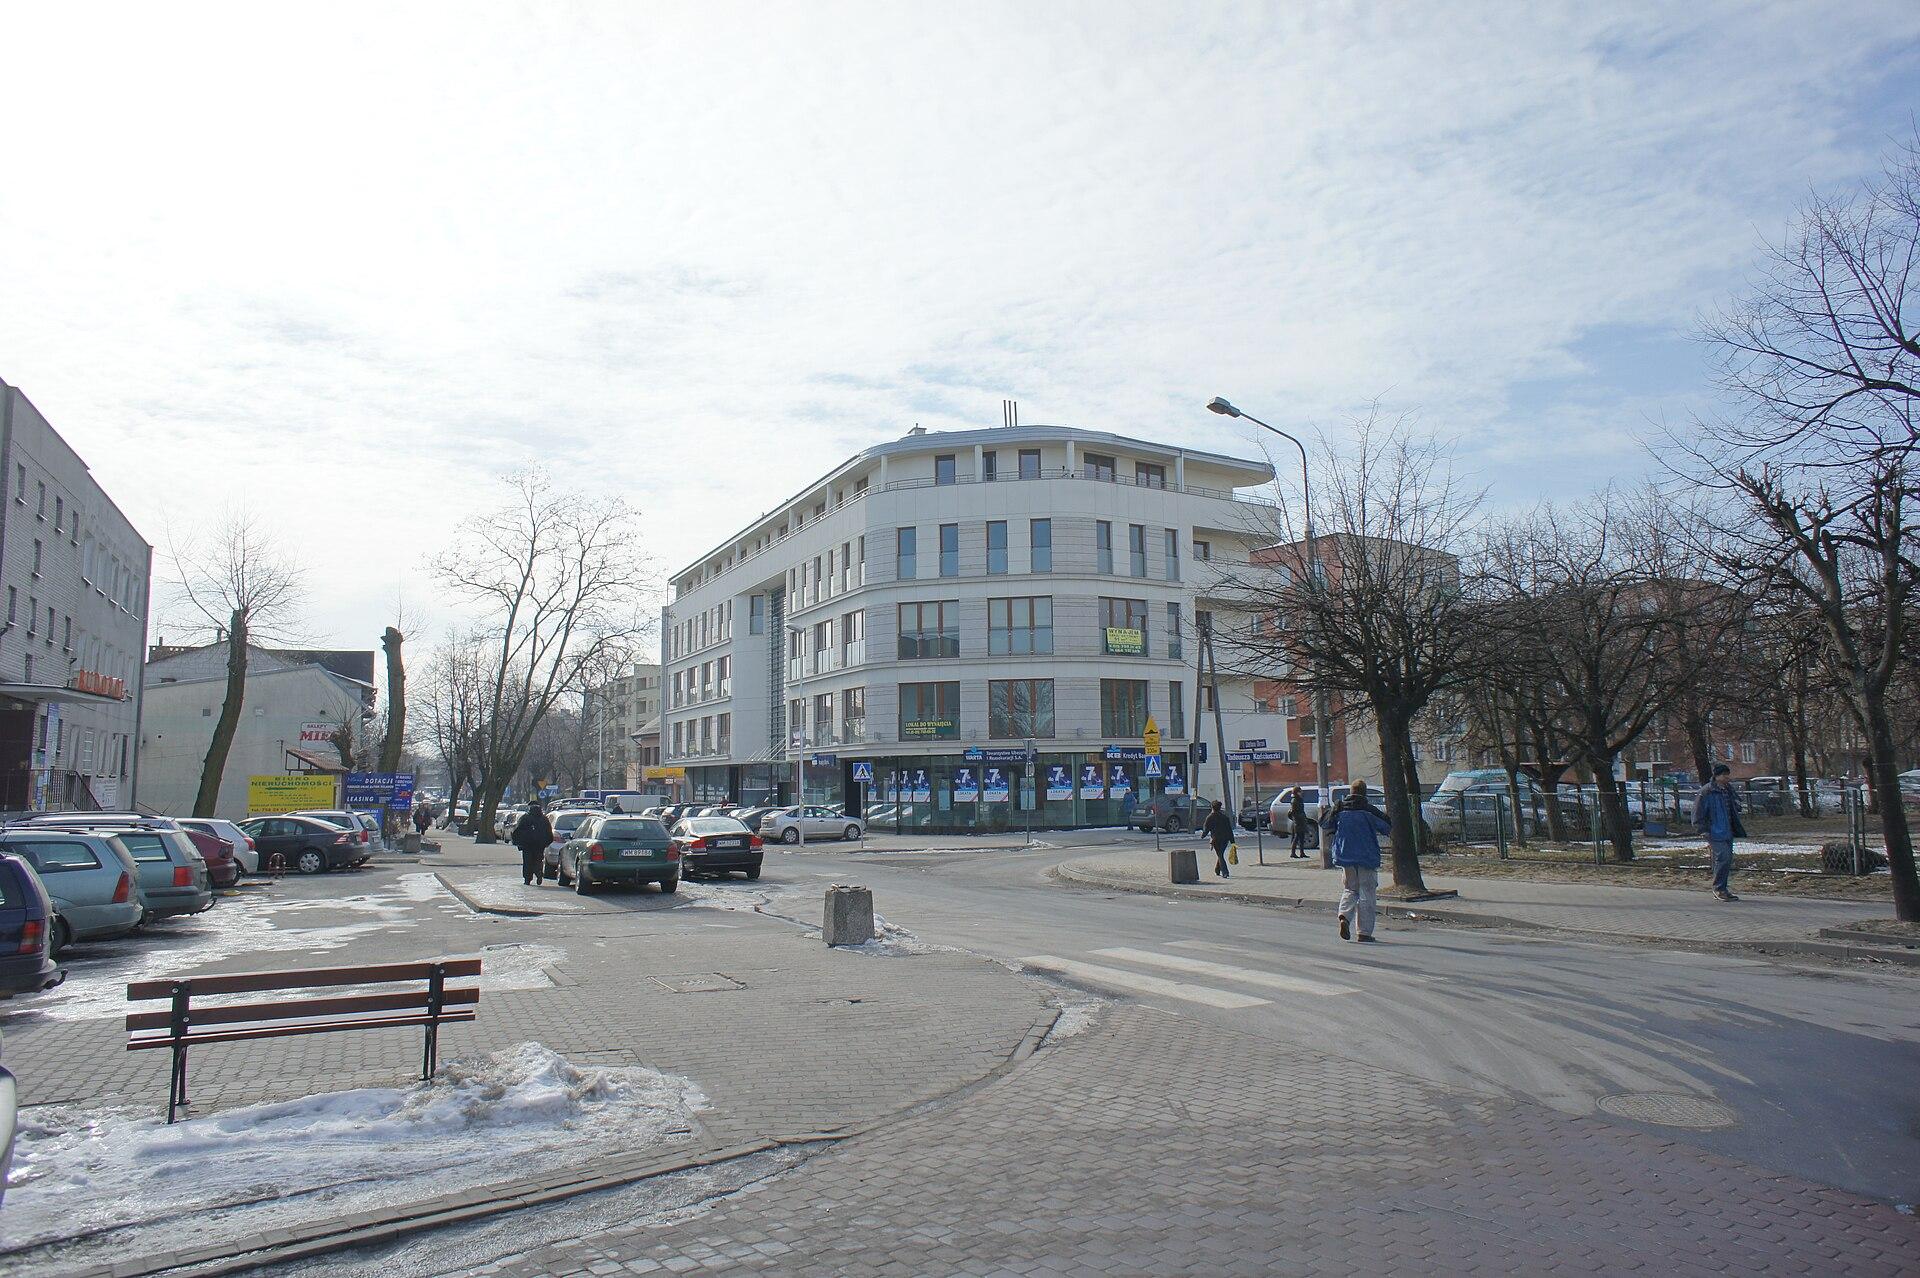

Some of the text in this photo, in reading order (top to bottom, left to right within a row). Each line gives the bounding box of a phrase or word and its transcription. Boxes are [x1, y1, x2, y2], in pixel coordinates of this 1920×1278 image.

[1122, 752, 1138, 760] Kredyt
[1226, 752, 1281, 761] Tadeusza Kościuszki
